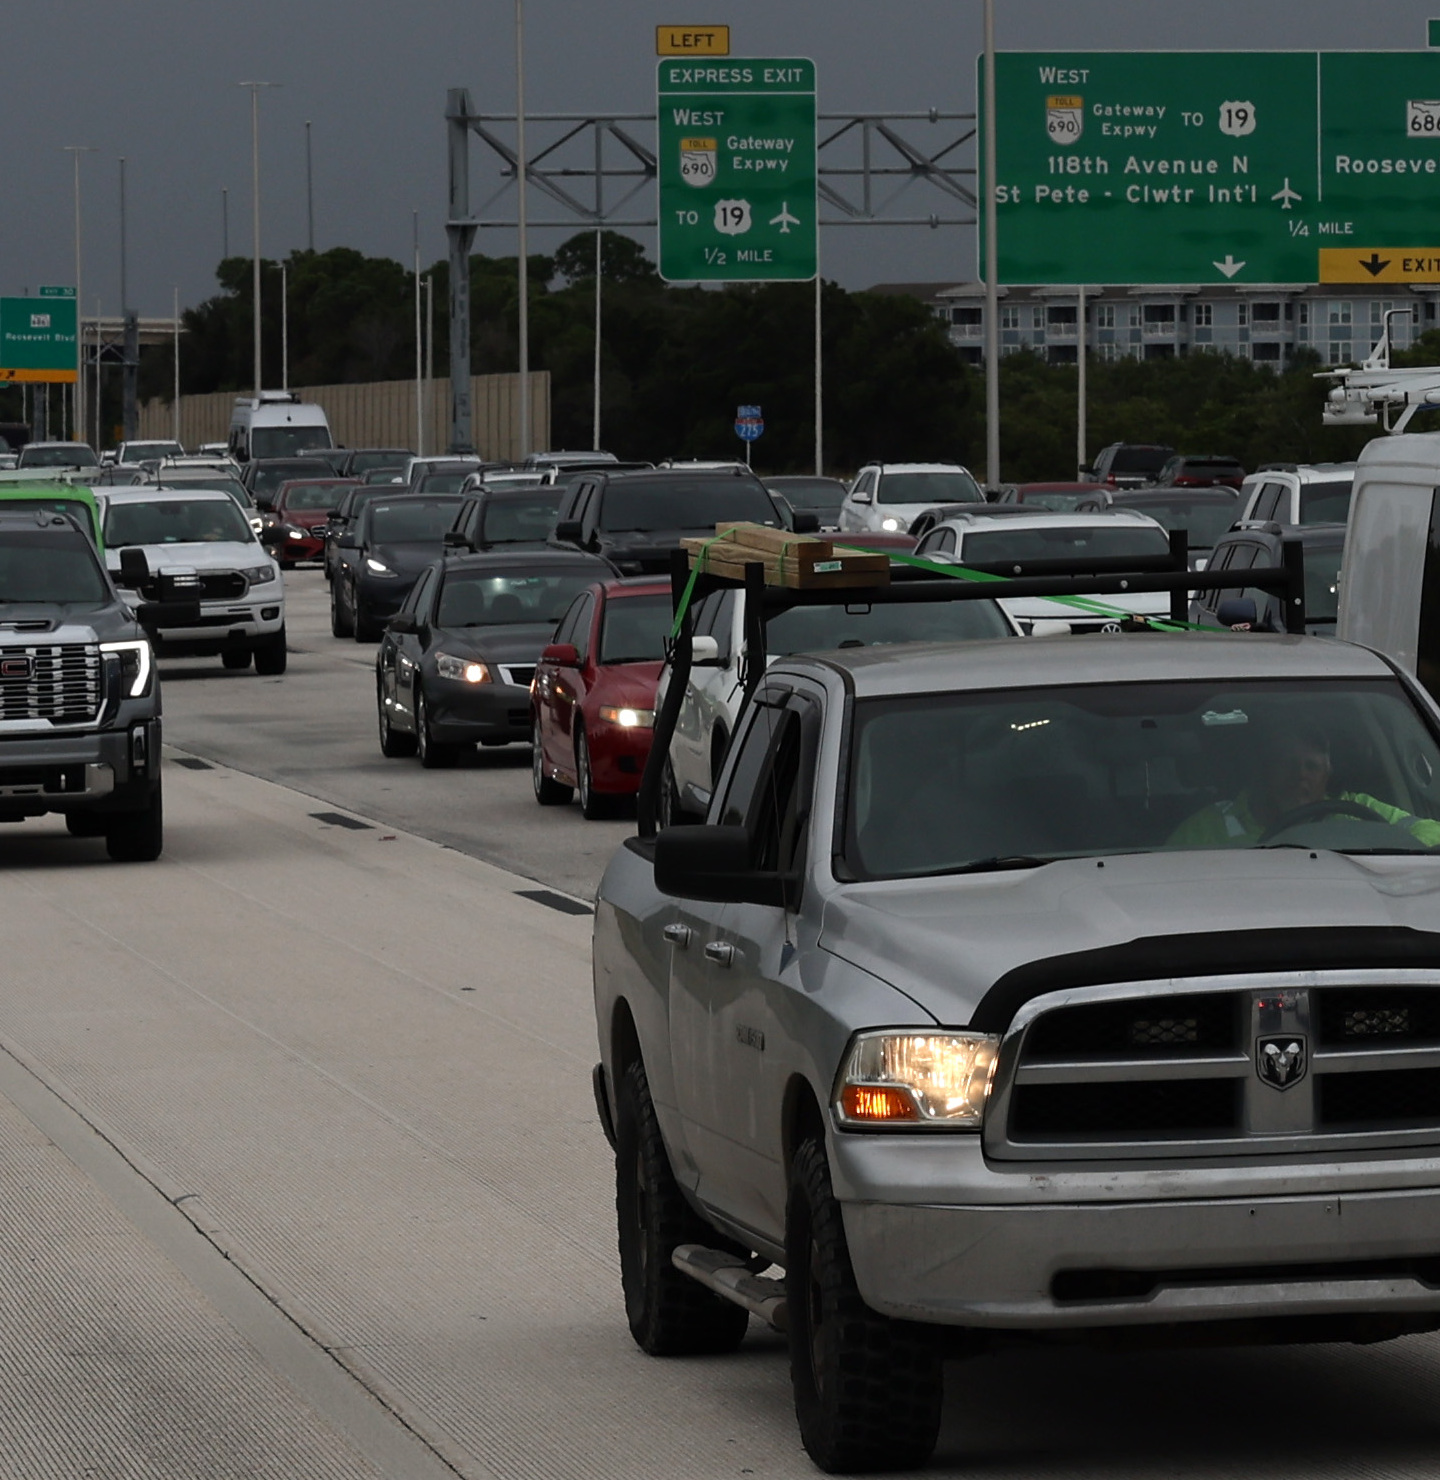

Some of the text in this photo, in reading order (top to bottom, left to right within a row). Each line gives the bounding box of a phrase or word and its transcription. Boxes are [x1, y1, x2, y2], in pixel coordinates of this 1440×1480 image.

[670, 33, 715, 47] LEFT
[670, 68, 803, 83] EXPRESS EXIT
[1093, 103, 1166, 119] Gateway
[1181, 108, 1249, 128] TO 19
[1048, 121, 1075, 132] 690
[1101, 122, 1157, 138] Expwy
[688, 140, 708, 148] TOLL
[727, 135, 794, 153] Gateway
[682, 163, 709, 175] 690
[733, 157, 788, 172] Expwy
[1048, 155, 1249, 174] 118th Avenue N
[994, 184, 1021, 204] St
[1035, 184, 1090, 204] Pete
[1126, 184, 1194, 203] Clwtr
[1208, 184, 1257, 203] Int'l
[676, 206, 744, 227] TO 19
[1318, 222, 1354, 235] MILE
[737, 249, 773, 262] MILE
[740, 424, 759, 437] 275
